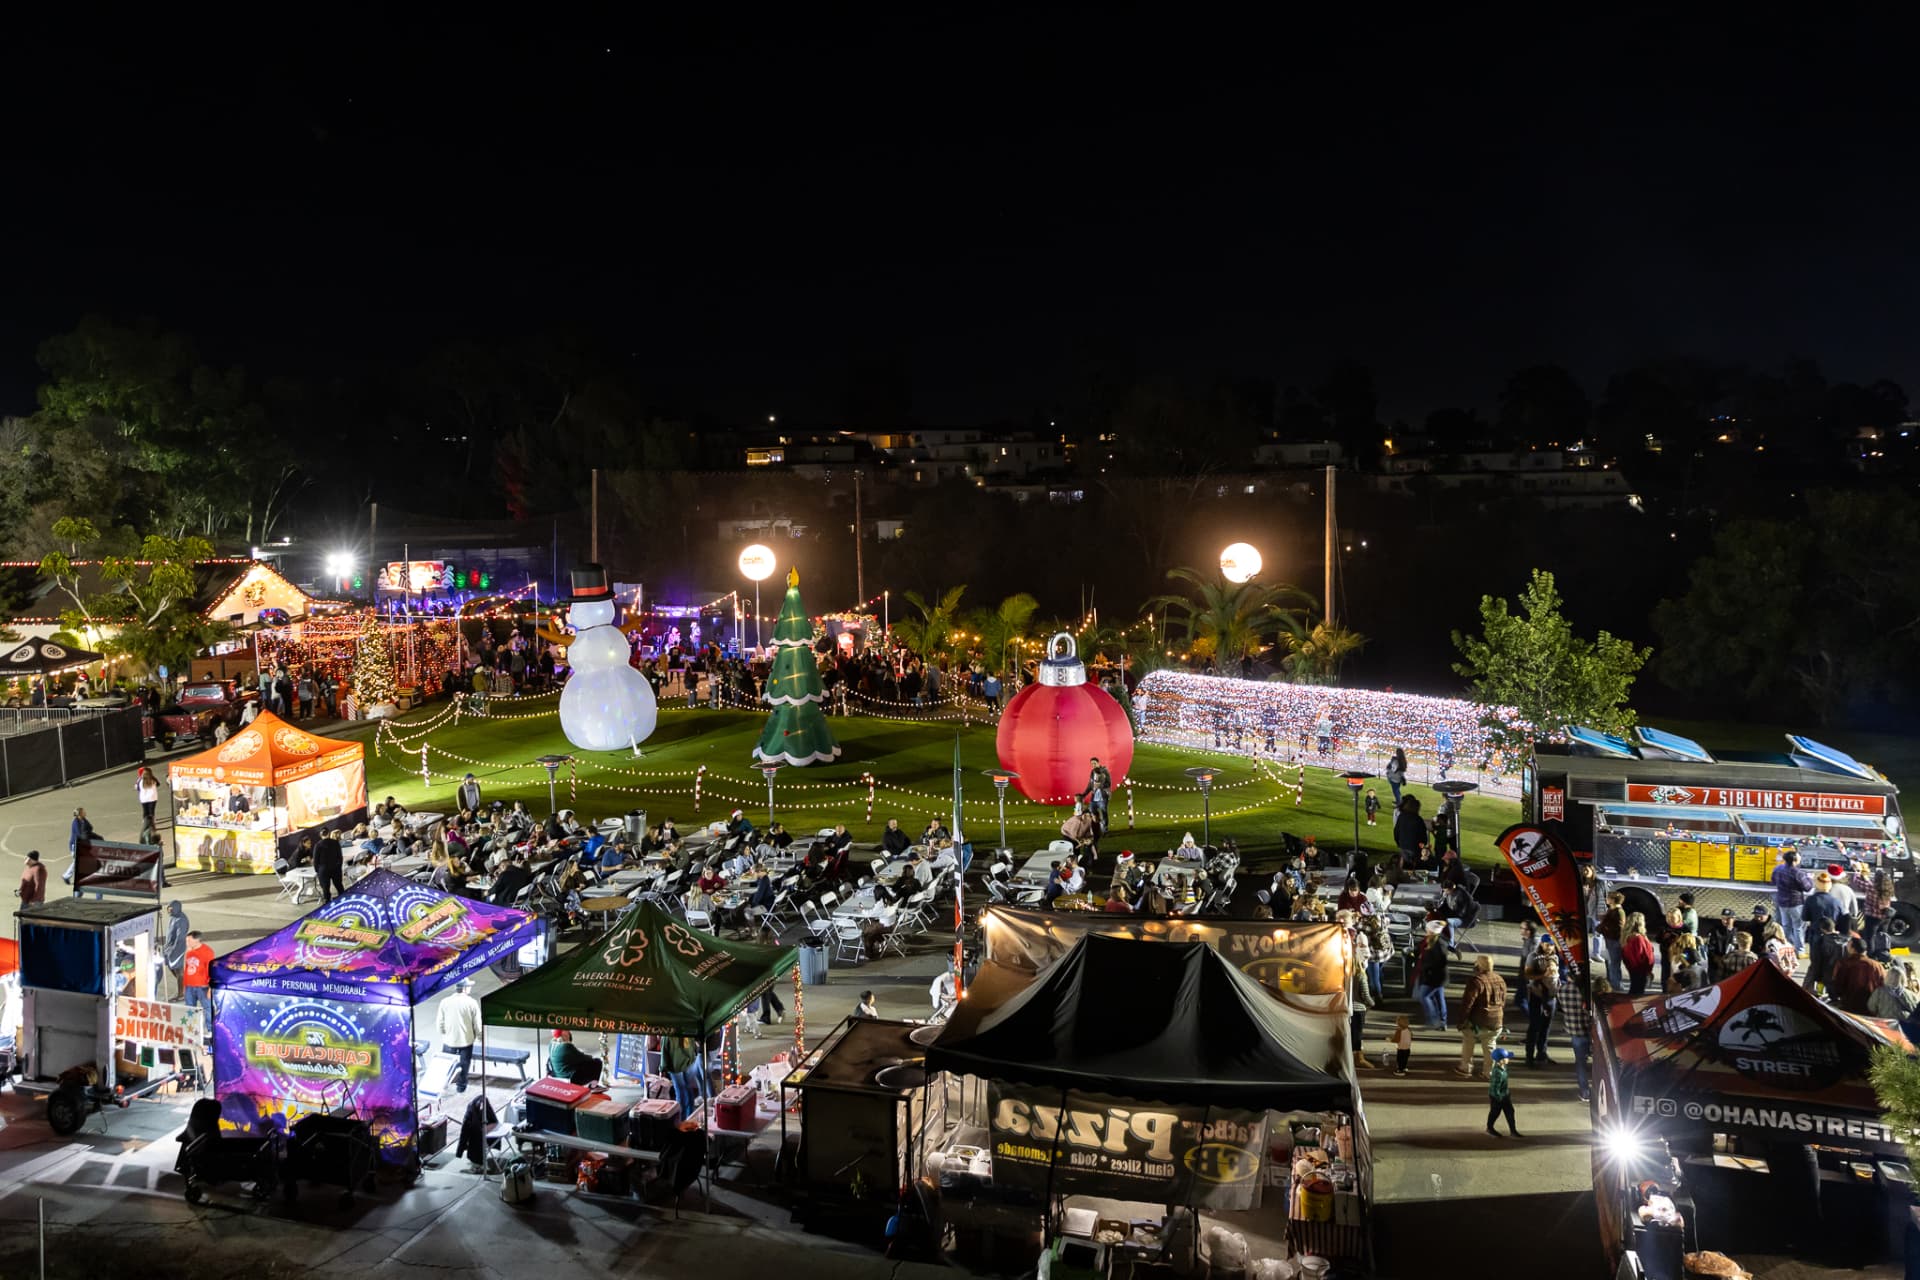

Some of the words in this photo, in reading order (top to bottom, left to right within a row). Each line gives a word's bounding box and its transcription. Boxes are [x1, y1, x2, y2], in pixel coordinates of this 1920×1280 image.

[1702, 789, 1710, 805] 7
[1719, 790, 1794, 809] SIBLINGS
[1523, 859, 1550, 875] STREET
[1528, 885, 1552, 922] FUSION
[252, 979, 277, 988] SIMPLE
[282, 979, 318, 992] PERSONAL
[323, 983, 367, 996] MEMORABLE
[573, 971, 626, 982] EMERALD
[629, 974, 654, 986] ISLE
[504, 1010, 512, 1020] A
[515, 1011, 542, 1023] GOLF
[546, 1013, 590, 1028] COURSE
[593, 1017, 616, 1030] FOR
[1735, 1056, 1814, 1077] STREET
